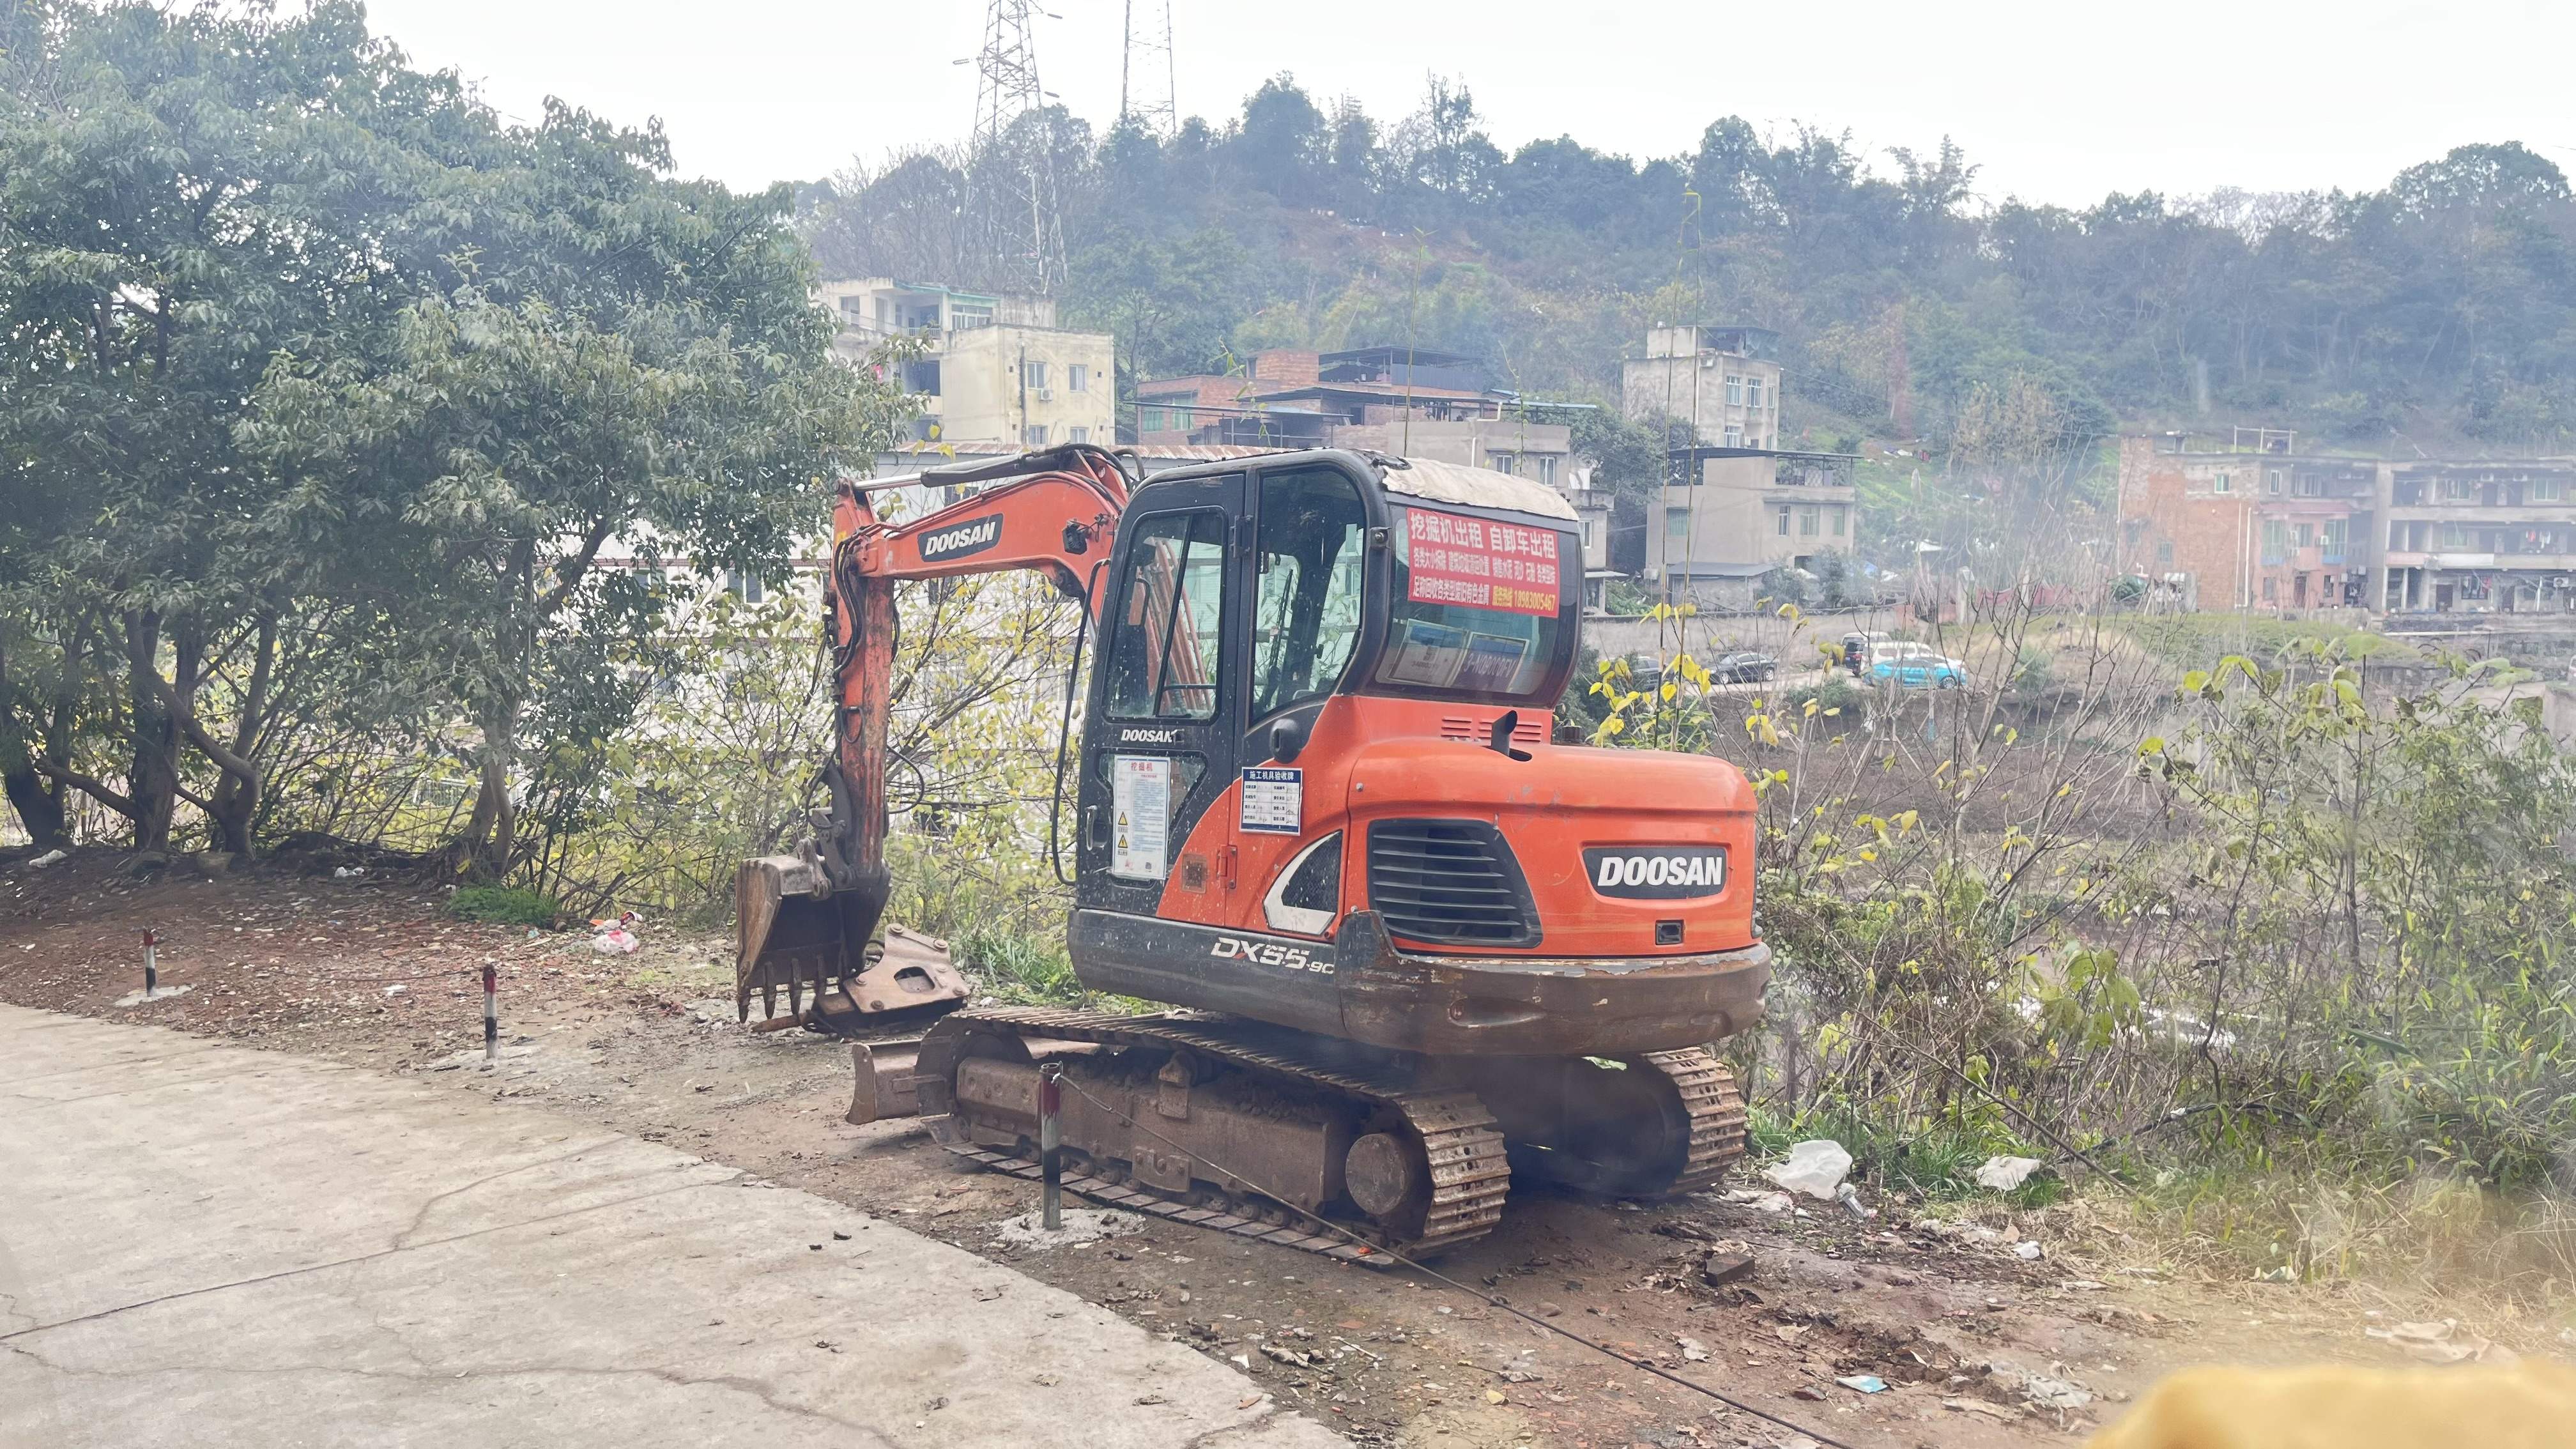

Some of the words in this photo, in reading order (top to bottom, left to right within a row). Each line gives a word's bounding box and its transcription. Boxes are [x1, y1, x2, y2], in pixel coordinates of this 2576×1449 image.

[924, 521, 996, 556] DOOSAN
[1410, 512, 1484, 548] 挖掘机出租
[1489, 525, 1556, 559] 自卸车出租
[1249, 770, 1294, 781] 施工机具验收牌
[1597, 856, 1722, 886] DOOSAN
